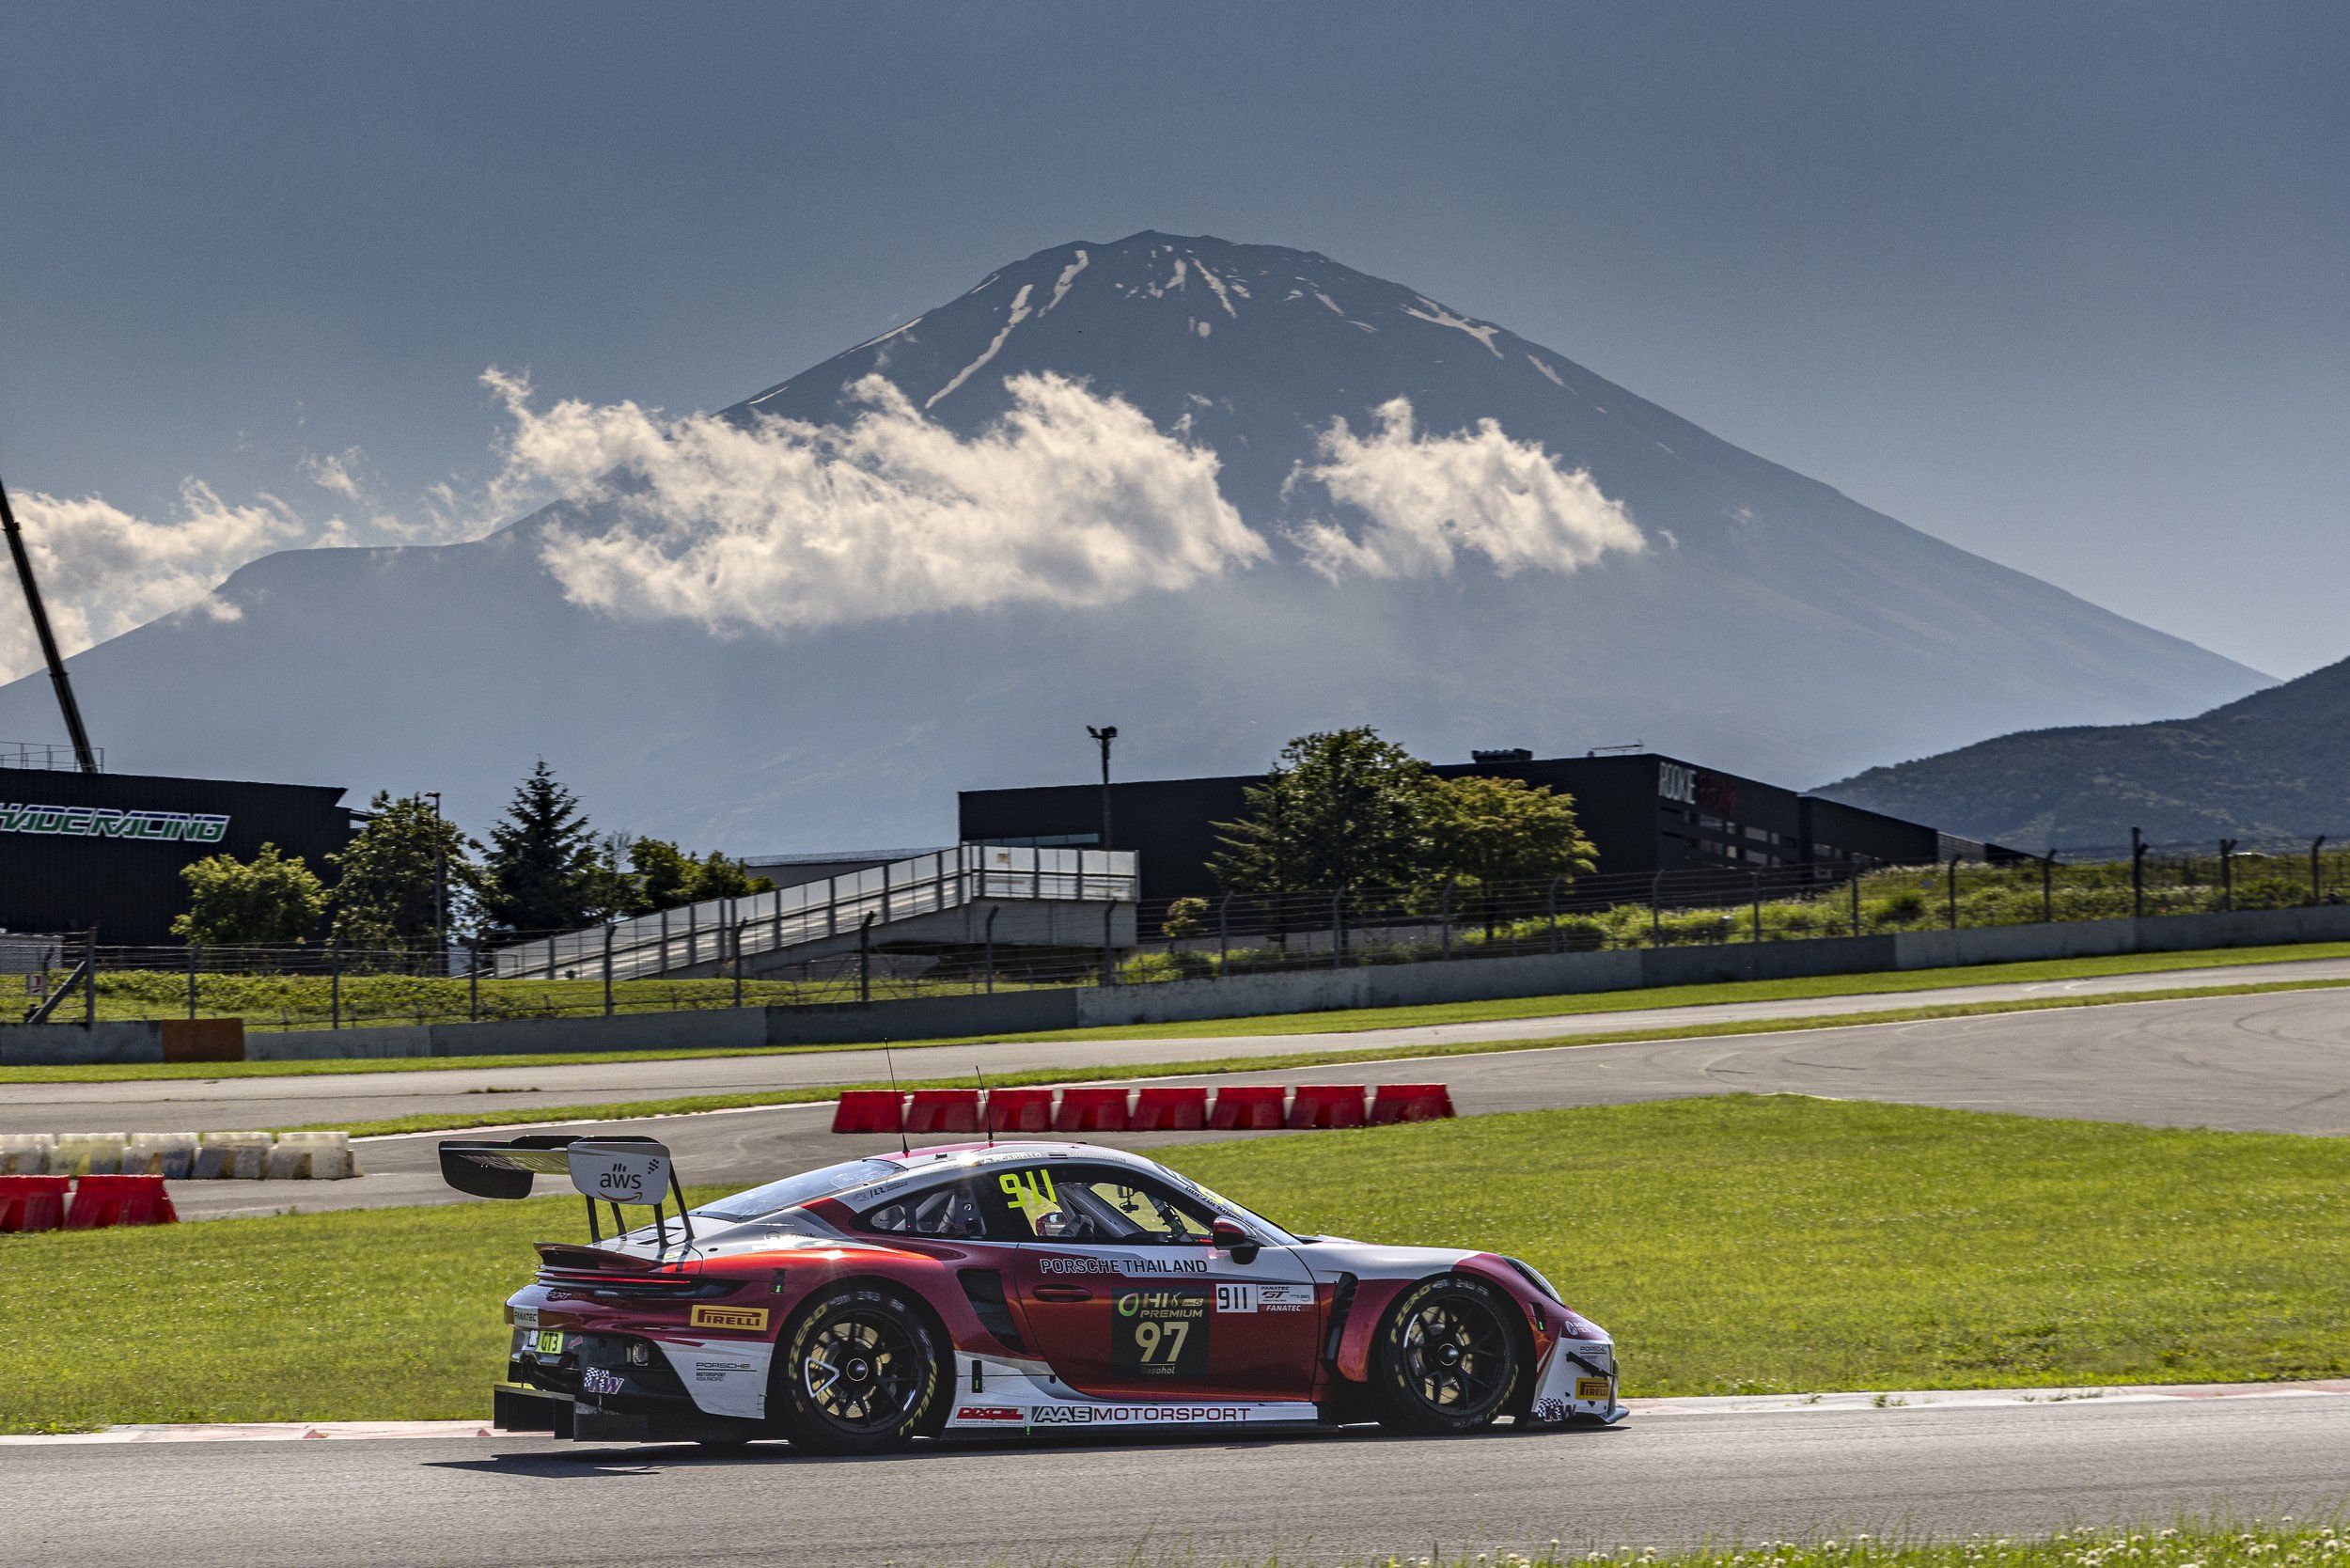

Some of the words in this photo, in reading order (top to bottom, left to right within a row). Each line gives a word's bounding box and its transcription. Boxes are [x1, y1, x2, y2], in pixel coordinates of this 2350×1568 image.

[600, 1172, 642, 1189] aws
[999, 1169, 1057, 1209] 911
[1040, 1259, 1120, 1274] PORSCHE
[1122, 1260, 1208, 1273] THAILAND
[1142, 1293, 1168, 1308] HI
[1218, 1287, 1247, 1309] 911
[697, 1309, 761, 1326] PIRELLI
[1140, 1309, 1203, 1318] PREMIUM
[541, 1332, 559, 1352] GT3
[1136, 1322, 1188, 1362] 97
[588, 1377, 624, 1394] KW
[1580, 1382, 1609, 1396] PIRELLI
[956, 1407, 1024, 1419] DIXCEL
[1035, 1406, 1092, 1422] AAS
[1094, 1407, 1250, 1420] MOTORSPORT
